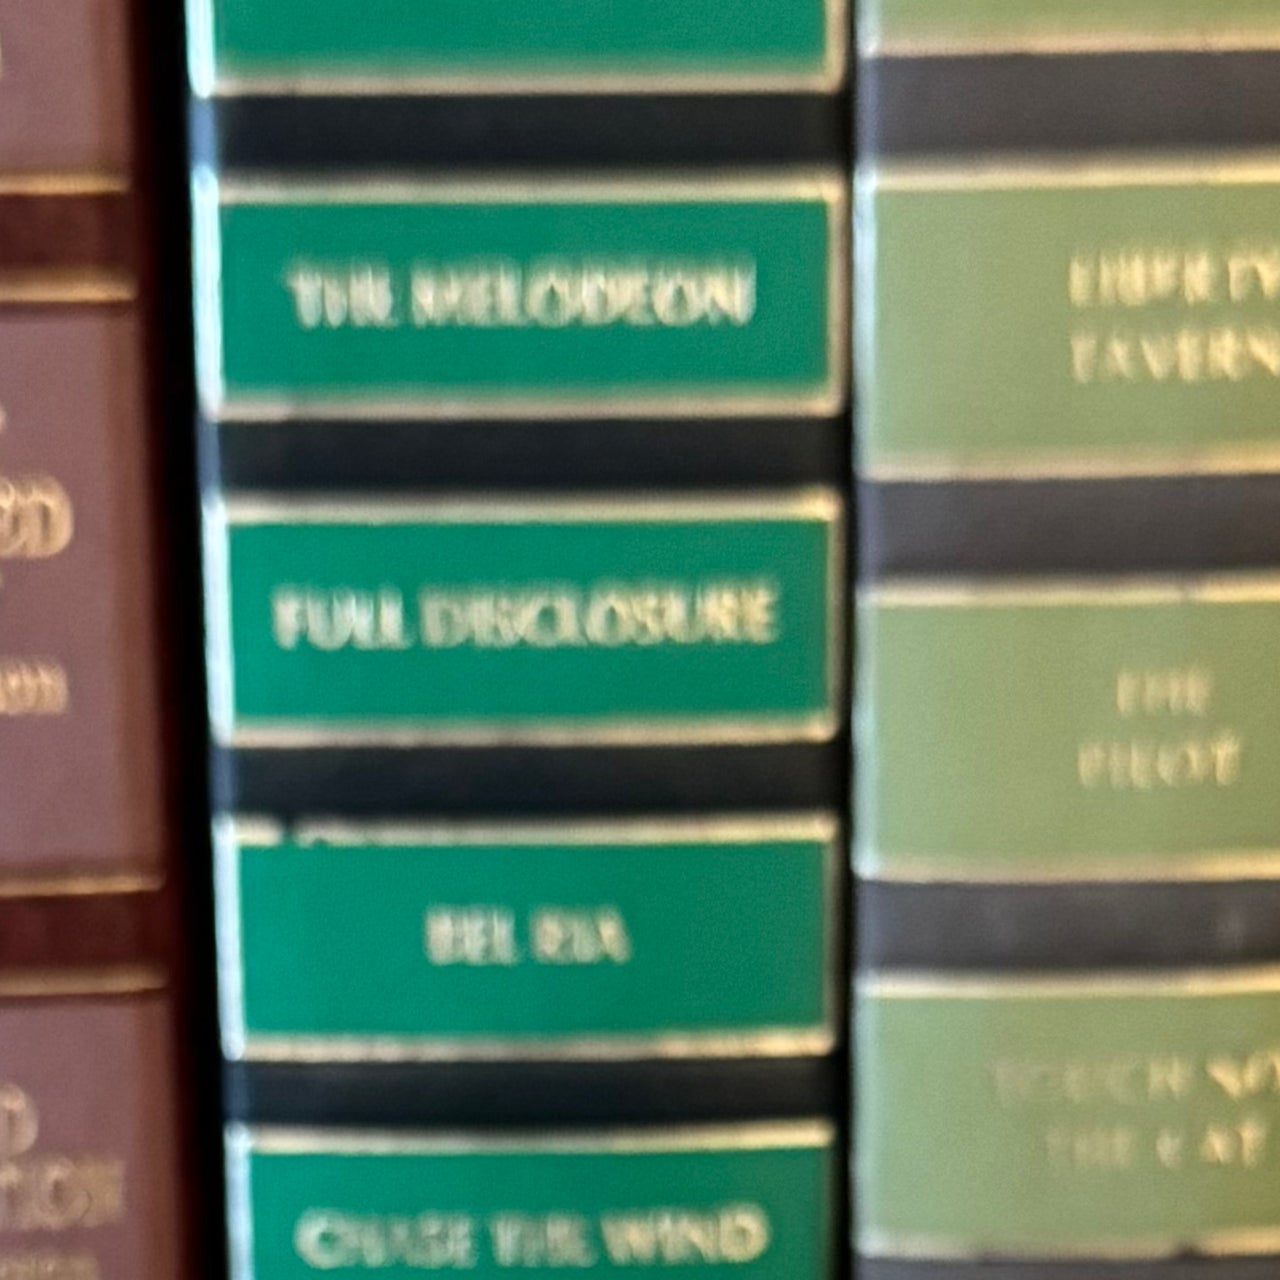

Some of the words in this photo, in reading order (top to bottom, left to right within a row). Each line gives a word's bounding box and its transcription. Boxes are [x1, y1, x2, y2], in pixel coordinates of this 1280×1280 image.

[410, 253, 757, 327] MELODEON
[271, 583, 410, 650] FULL
[418, 574, 778, 648] DISCLOSURE
[599, 1200, 771, 1266] WIND
